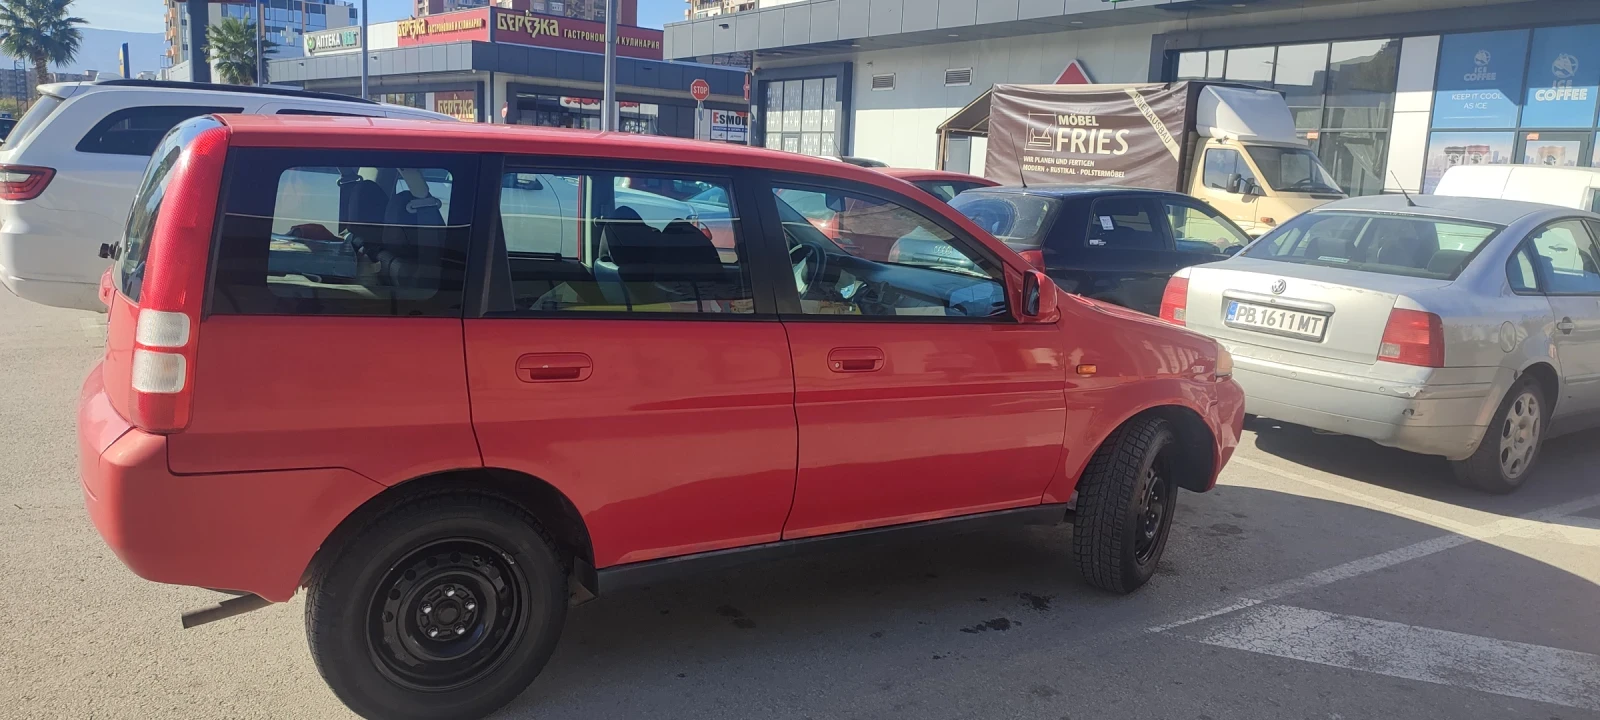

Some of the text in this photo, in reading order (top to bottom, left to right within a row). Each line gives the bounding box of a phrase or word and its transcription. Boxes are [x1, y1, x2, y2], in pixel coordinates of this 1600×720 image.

[497, 10, 560, 38] БЕРЁЗКА
[563, 29, 606, 43] ГАСТРОНОМ
[621, 36, 660, 50] КУЛИНАРИЯ
[316, 33, 341, 48] АПТЕКА
[1463, 73, 1497, 81] COFFEE
[693, 86, 708, 95] STOP
[1552, 80, 1573, 89] ICE
[1451, 93, 1471, 101] KEEP
[1480, 92, 1503, 100] COOL
[1535, 88, 1588, 101] COFFEE
[713, 111, 748, 126] ESMOK
[1058, 114, 1099, 127] MÖBEL
[1056, 127, 1130, 156] FRIES
[1068, 158, 1095, 167] FERTIGEN
[1023, 164, 1045, 172] MODERN
[1050, 167, 1076, 175] RUSTIKAL
[1080, 169, 1125, 178] POLSTERMÖBEL
